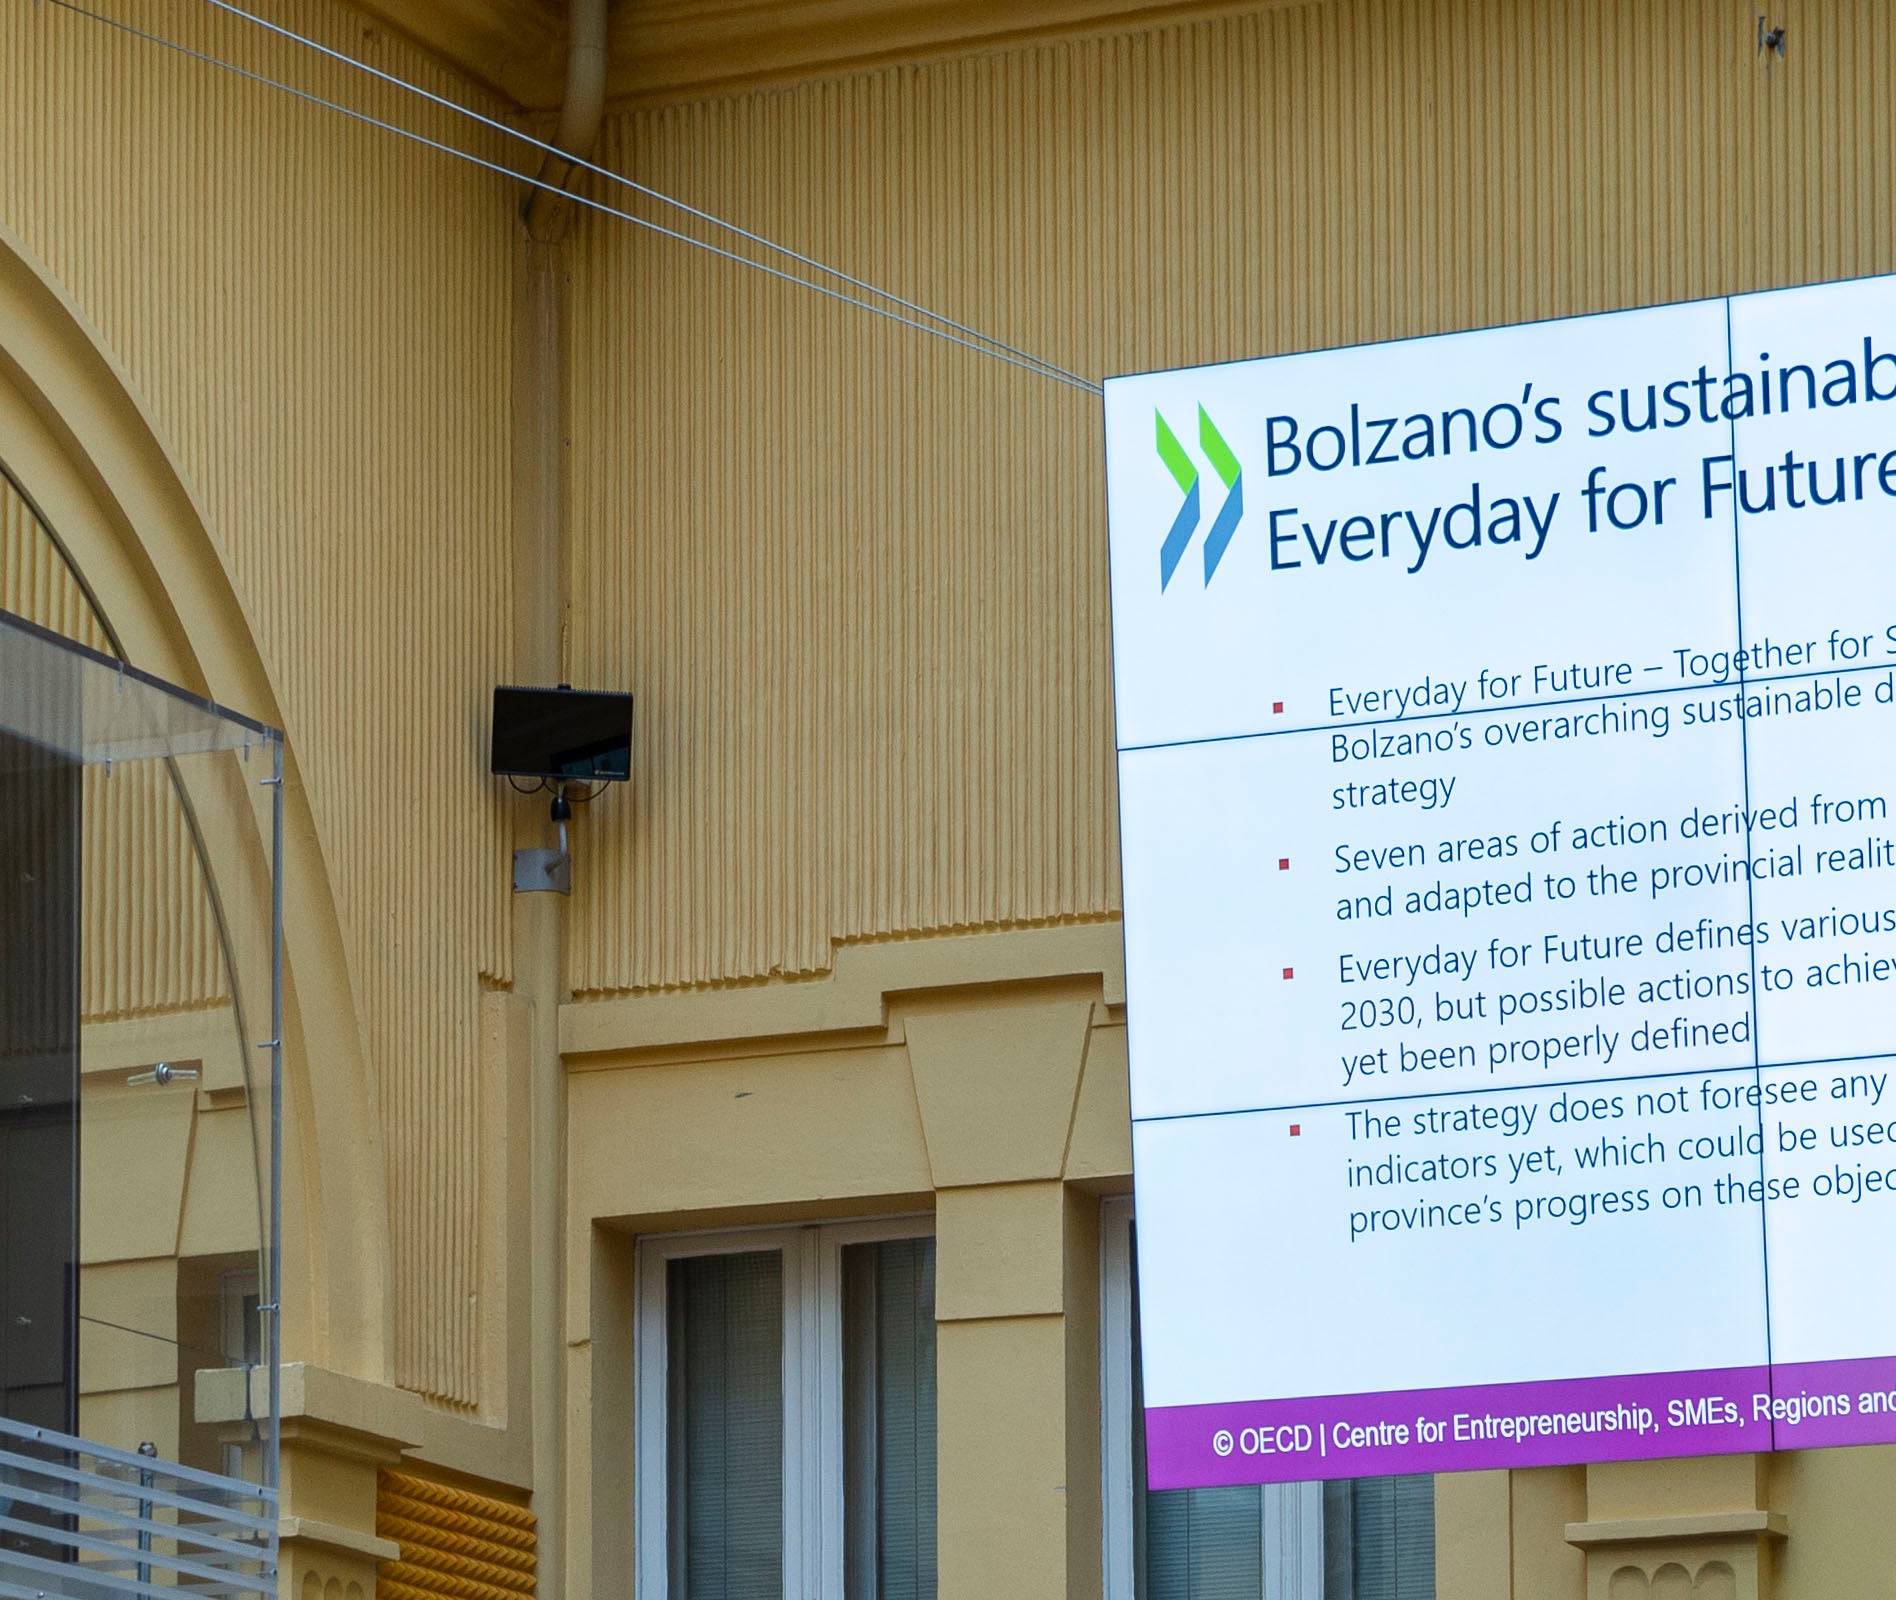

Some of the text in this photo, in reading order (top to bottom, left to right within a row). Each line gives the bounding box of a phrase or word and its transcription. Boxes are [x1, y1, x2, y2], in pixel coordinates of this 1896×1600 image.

[1269, 482, 1560, 574] Everyday
[1581, 466, 1677, 533] for
[1329, 676, 1467, 717] Everyday
[1477, 669, 1522, 700] for
[1534, 663, 1632, 694] Future
[1673, 637, 1816, 683] Together
[1827, 629, 1874, 661] for
[1484, 702, 1669, 746] overarching
[1683, 677, 1861, 726] sustainable
[1332, 776, 1456, 810] strategy
[1335, 844, 1425, 873] Seven
[1438, 835, 1518, 863] areas
[1530, 821, 1561, 854] of
[1572, 815, 1667, 850] action
[1680, 796, 1797, 839] derived
[1810, 793, 1886, 825] from
[1337, 885, 1392, 921] and
[1405, 871, 1532, 918] adapted
[1544, 874, 1575, 900] to
[1586, 864, 1638, 896] the
[1651, 844, 1802, 900] provincial
[1339, 944, 1477, 987] Everyday
[1487, 938, 1532, 969] for
[1544, 934, 1643, 964] Future
[1656, 918, 1769, 954] defines
[1781, 907, 1896, 941] various
[1341, 996, 1422, 1030] 2030,
[1435, 991, 1487, 1022] but
[1499, 976, 1625, 1026] possible
[1638, 969, 1750, 1003] actions
[1760, 965, 1793, 991] to
[1341, 1011, 1750, 1087] yet been properly defined
[1344, 1108, 1401, 1140] The
[1413, 1104, 1538, 1137] strategy
[1549, 1092, 1624, 1123] does
[1637, 1086, 1689, 1116] not
[1700, 1079, 1817, 1111] foresee
[1831, 1073, 1887, 1106] any
[1348, 1154, 1497, 1188] indicators
[1508, 1145, 1562, 1184] yet,
[1574, 1132, 1665, 1169] which
[1678, 1125, 1764, 1160] could
[1778, 1121, 1817, 1152] be
[1516, 1189, 1649, 1230] progress
[1662, 1185, 1701, 1209] on
[1714, 1173, 1799, 1205] these
[1239, 1424, 1312, 1455] OECD
[1332, 1421, 1410, 1449] Centre
[1415, 1417, 1447, 1444] for
[1453, 1402, 1659, 1443] Entrepreneurship,
[1667, 1396, 1744, 1427] SMEs,
[1753, 1391, 1851, 1425] Regions
